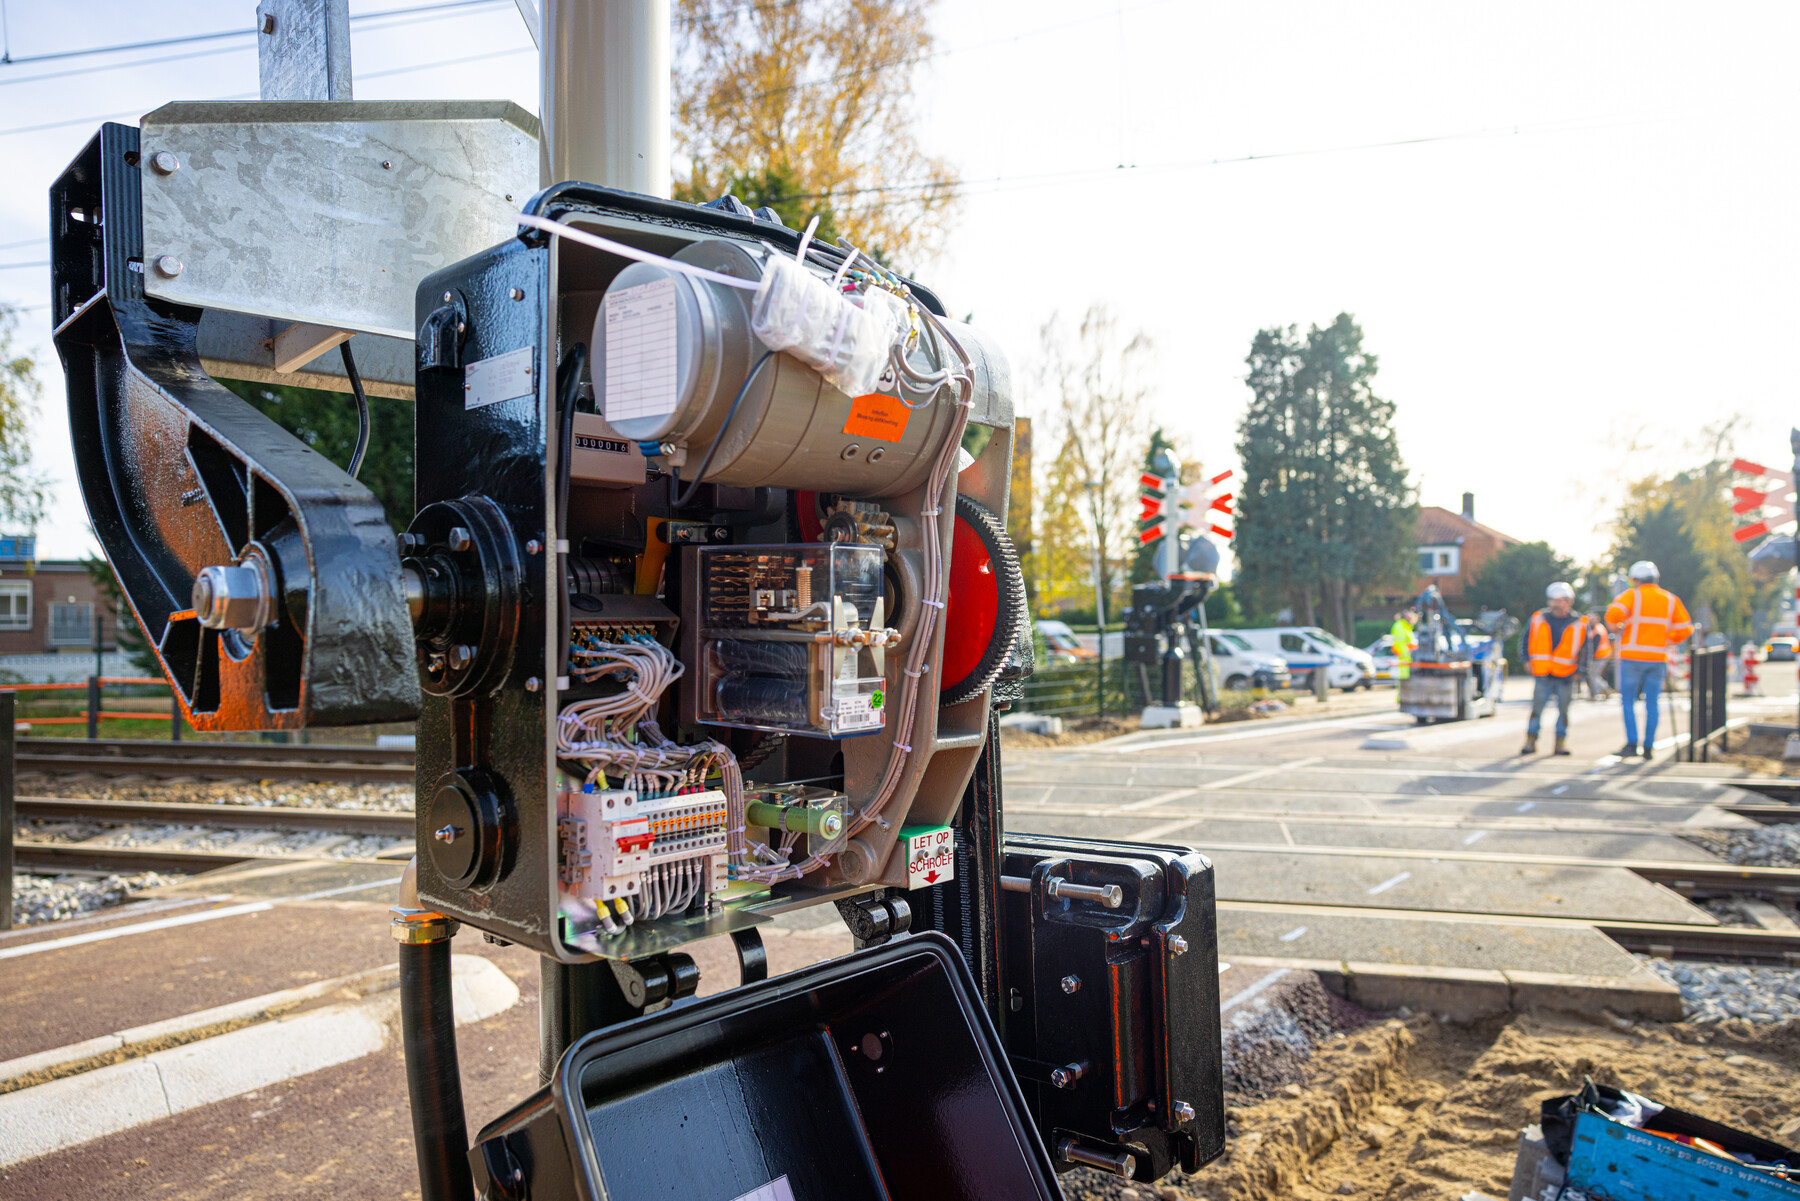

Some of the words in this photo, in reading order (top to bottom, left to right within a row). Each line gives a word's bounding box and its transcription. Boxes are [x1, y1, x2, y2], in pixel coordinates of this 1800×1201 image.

[575, 437, 626, 452] 0000016
[873, 693, 882, 703] 22
[914, 835, 932, 850] LET
[936, 831, 949, 845] OP
[909, 852, 953, 874] SCHROEF
